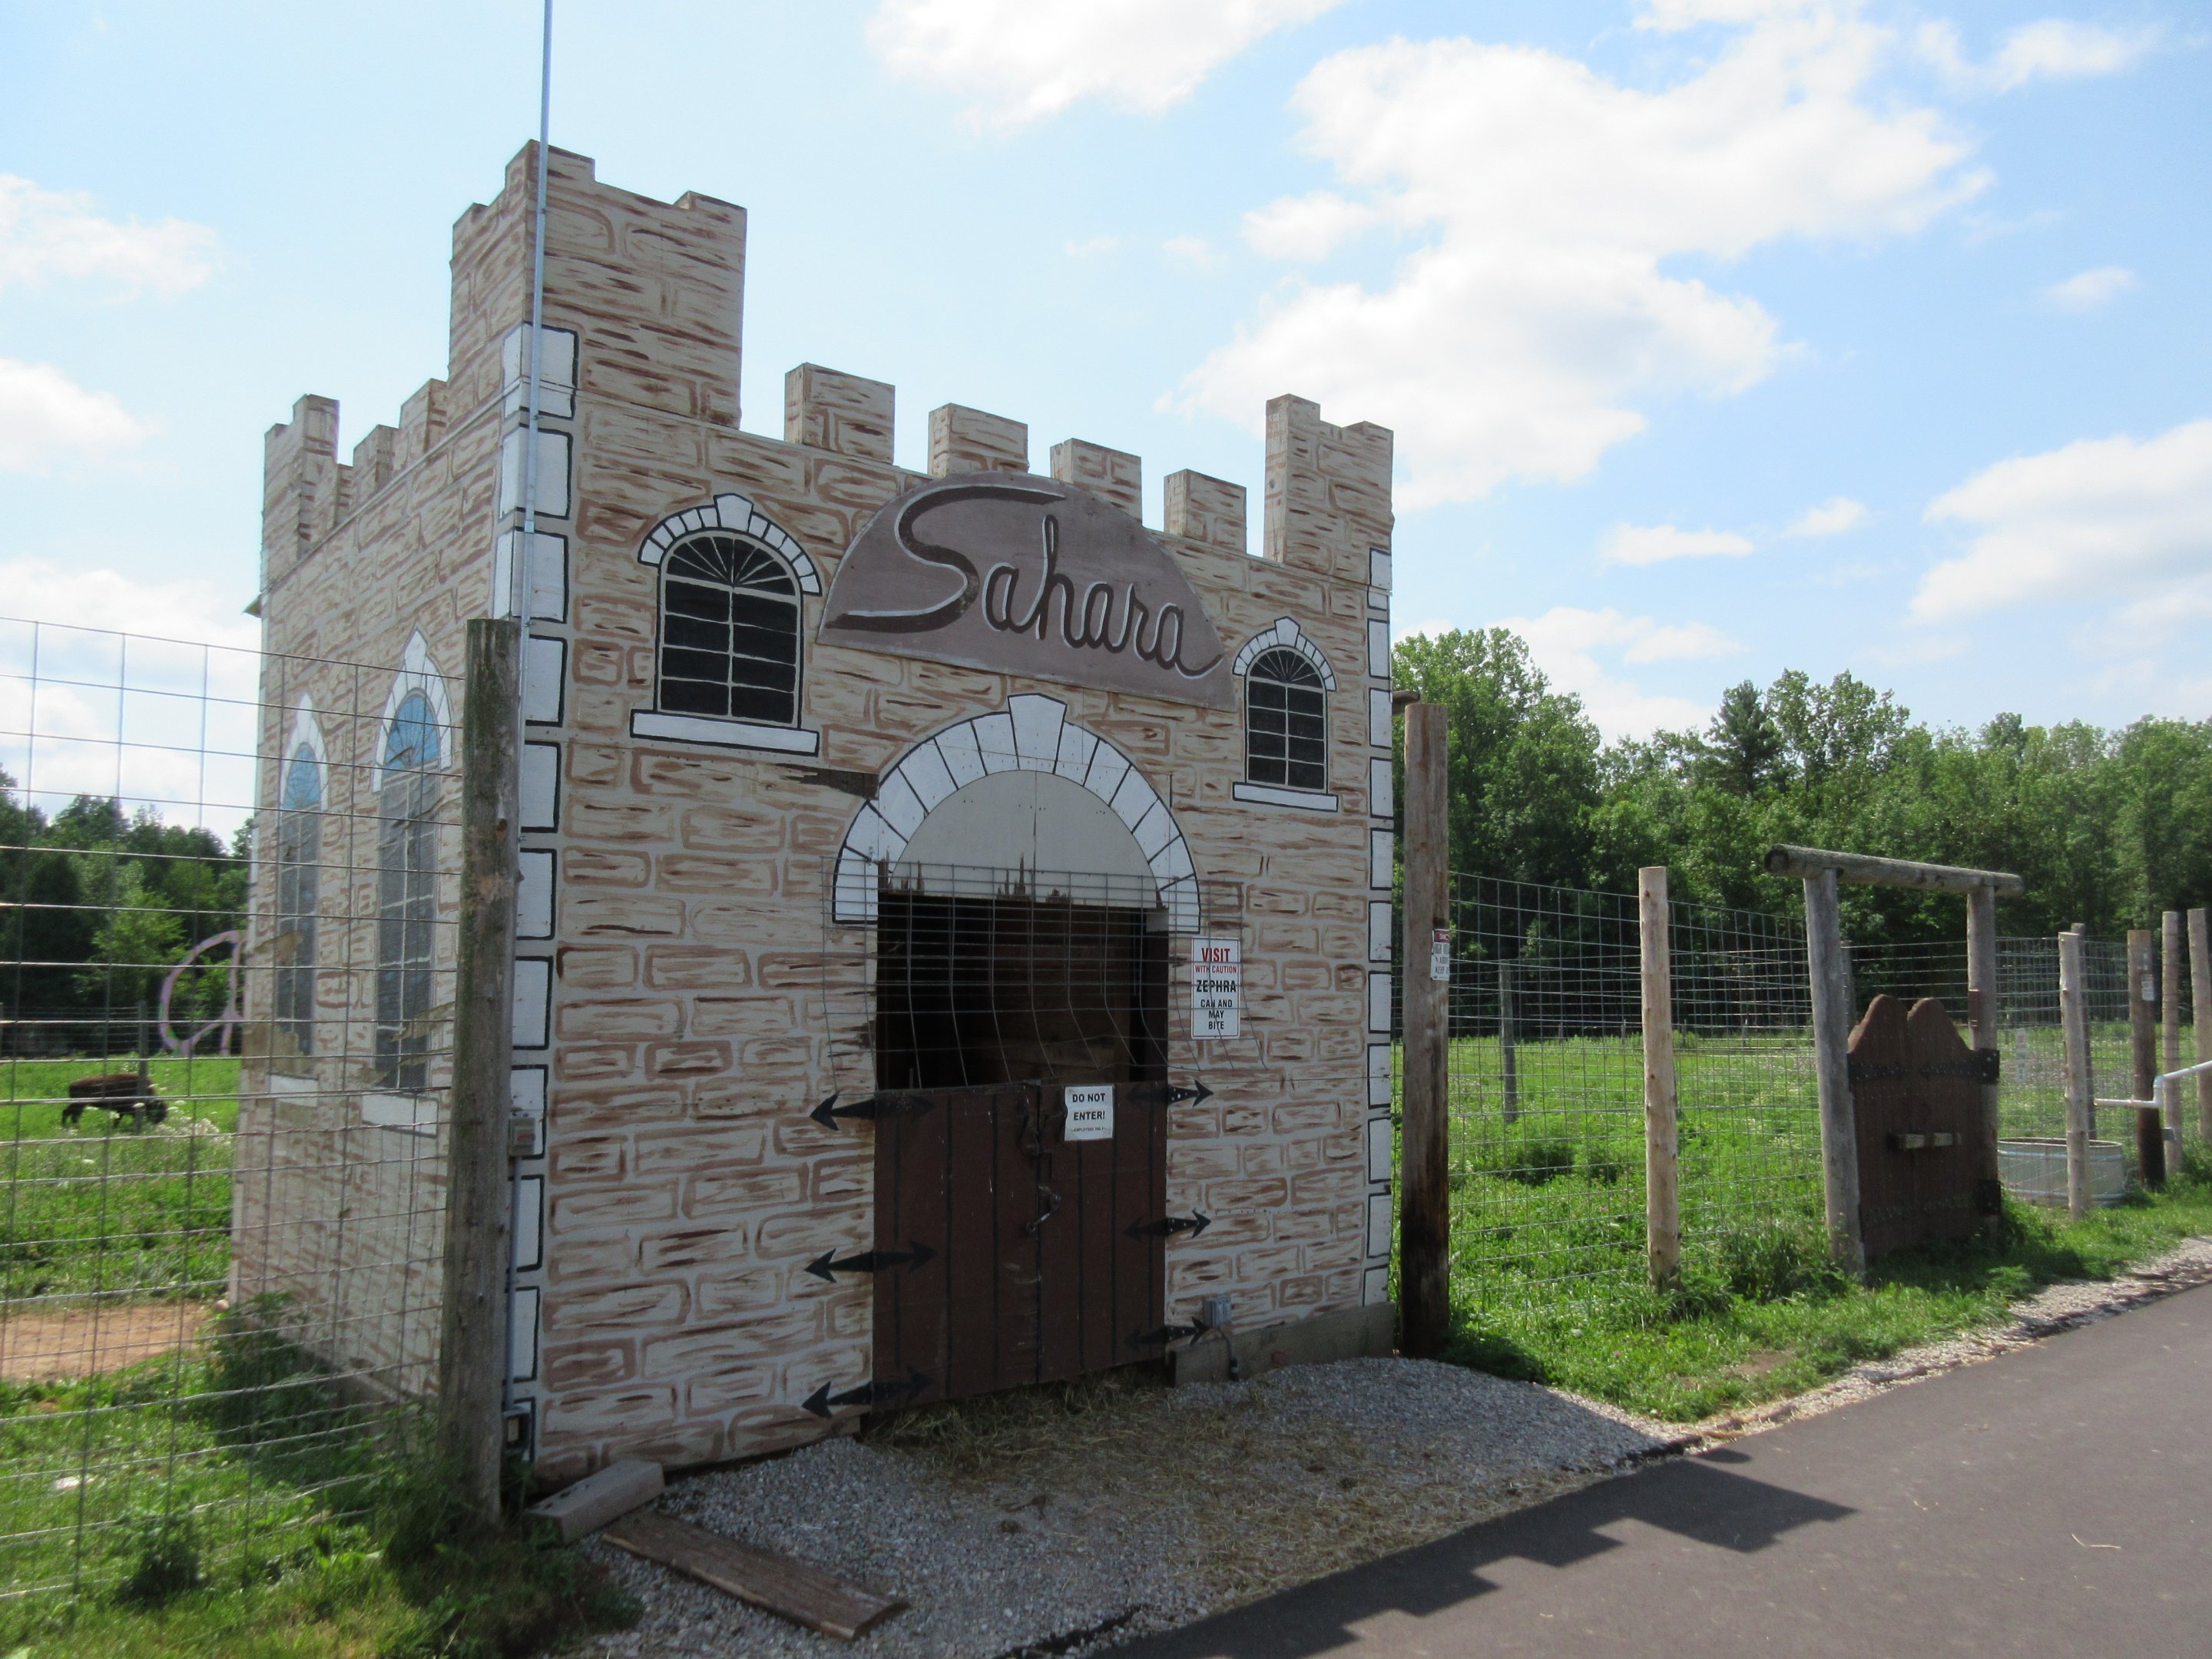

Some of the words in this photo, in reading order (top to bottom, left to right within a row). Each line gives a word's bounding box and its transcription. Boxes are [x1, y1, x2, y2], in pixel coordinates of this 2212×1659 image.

[824, 485, 1224, 679] Sahara
[1201, 947, 1230, 962] VISIT
[1212, 965, 1237, 974] CAUTION
[1196, 979, 1237, 992] ZEPHRA
[1200, 999, 1215, 1008] CAN
[1217, 999, 1233, 1008] AND
[1208, 1010, 1224, 1018] MAY
[1208, 1021, 1224, 1030] BITE
[1072, 1094, 1084, 1102] DO
[1088, 1093, 1105, 1102] NOT
[1073, 1111, 1105, 1121] ENTER!
